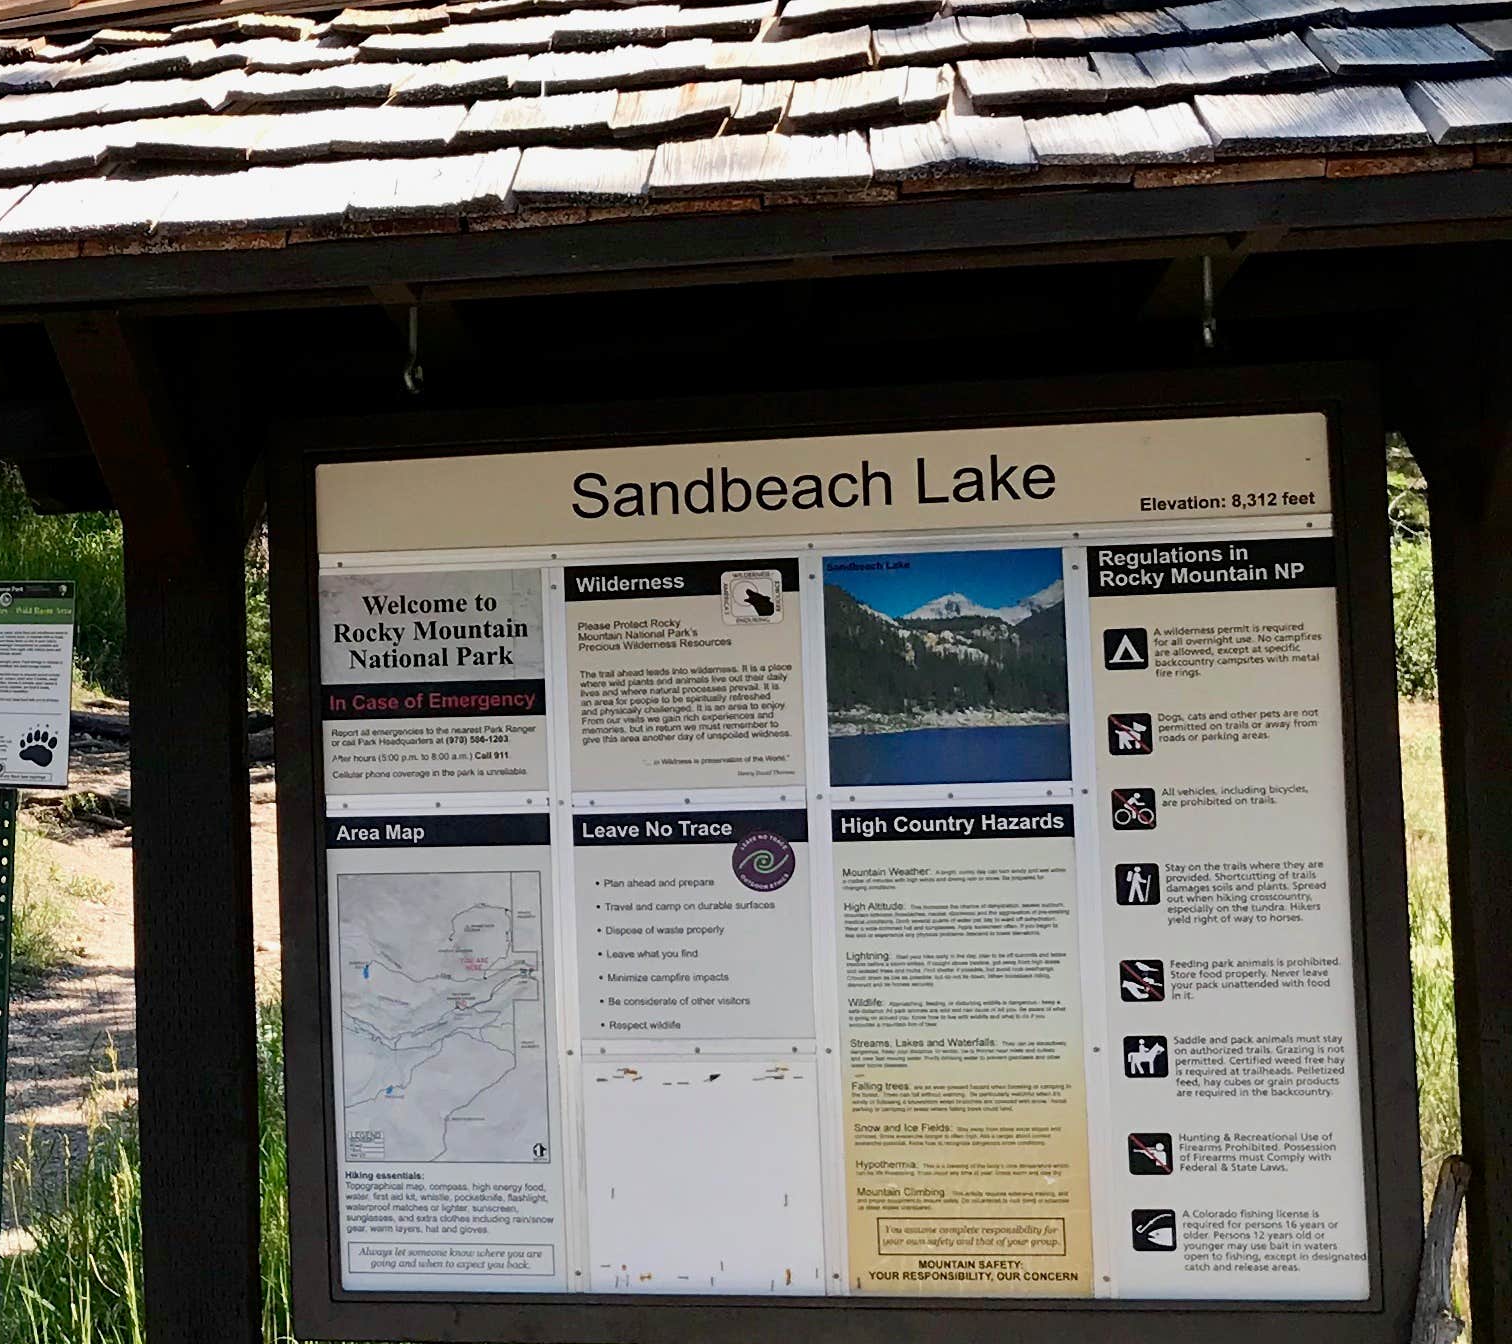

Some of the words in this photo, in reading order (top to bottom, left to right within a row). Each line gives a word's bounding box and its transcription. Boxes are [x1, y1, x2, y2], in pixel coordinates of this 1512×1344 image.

[572, 460, 891, 518] Sandbeach
[917, 454, 1055, 503] Lake
[1140, 495, 1225, 510] Elevation:
[1232, 492, 1276, 509] 8,312
[1282, 491, 1315, 504] feet
[1098, 546, 1222, 569] Regulations
[1229, 544, 1247, 560] in
[1099, 568, 1164, 588] Rocky
[1171, 564, 1267, 583] Mountain
[1275, 562, 1304, 578] NP
[576, 576, 684, 592] Wilderness
[361, 595, 467, 614] Welcome
[474, 594, 496, 611] to
[577, 622, 610, 630] Please
[613, 620, 648, 629] Protect
[650, 618, 680, 631] Rocky
[1163, 627, 1214, 635] wilderness
[1217, 624, 1249, 636] permit
[1262, 622, 1304, 634] required
[334, 622, 405, 646] Rocky
[413, 618, 527, 640] Mountain
[578, 632, 622, 640] Mountain
[625, 629, 664, 639] National
[667, 628, 698, 637] Park's
[578, 642, 620, 651] Precious
[622, 640, 676, 649] Wilderness
[679, 638, 731, 647] Resources
[1185, 634, 1233, 646] overnight
[1273, 632, 1322, 644] campfires
[1217, 644, 1249, 654] except
[1264, 642, 1300, 654] specific
[348, 647, 448, 668] National
[456, 645, 513, 665] Park
[1154, 655, 1214, 669] backcountry
[1216, 656, 1264, 665] campsites
[1266, 653, 1288, 662] with
[1291, 653, 1319, 661] metal
[330, 695, 345, 710] In
[352, 695, 398, 709] Case
[404, 693, 423, 708] of
[429, 693, 535, 710] Emergency
[582, 822, 639, 837] Leave
[645, 820, 672, 836] No
[678, 820, 732, 835] Trace
[841, 816, 886, 836] High
[893, 816, 974, 834] Country
[981, 812, 1064, 830] Hazards
[336, 825, 379, 840] Area
[386, 824, 424, 842] Map
[603, 878, 624, 887] Plan
[658, 878, 675, 886] and
[678, 879, 714, 888] prepare
[604, 902, 632, 910] Travel
[697, 900, 732, 909] durable
[735, 900, 775, 909] surfaces
[843, 902, 865, 912] High
[605, 926, 642, 936] Dispose
[645, 925, 654, 934] of
[686, 925, 724, 935] properly
[606, 949, 634, 958] Leave
[661, 951, 678, 959] you
[681, 949, 698, 957] find
[650, 972, 690, 983] campfire
[692, 973, 729, 982] impacts
[608, 997, 620, 1005] Be
[679, 996, 688, 1004] of
[609, 1020, 648, 1030] Respect
[649, 1020, 680, 1028] wildlife
[895, 1038, 923, 1047] Lakes
[926, 1038, 944, 1046] and
[851, 1081, 882, 1092] Falling
[854, 1123, 880, 1131] Snow
[904, 1123, 918, 1131] Ice
[345, 1171, 373, 1182] Hiking
[856, 1187, 900, 1196] Mountain
[918, 1260, 975, 1268] MOUNTAIN
[978, 1260, 1022, 1269] SAFETY:
[868, 1271, 899, 1280] YOUR
[902, 1271, 993, 1281] RESPONSIBILITY,
[996, 1272, 1020, 1280] OUR
[1023, 1271, 1078, 1280] CONCERN
